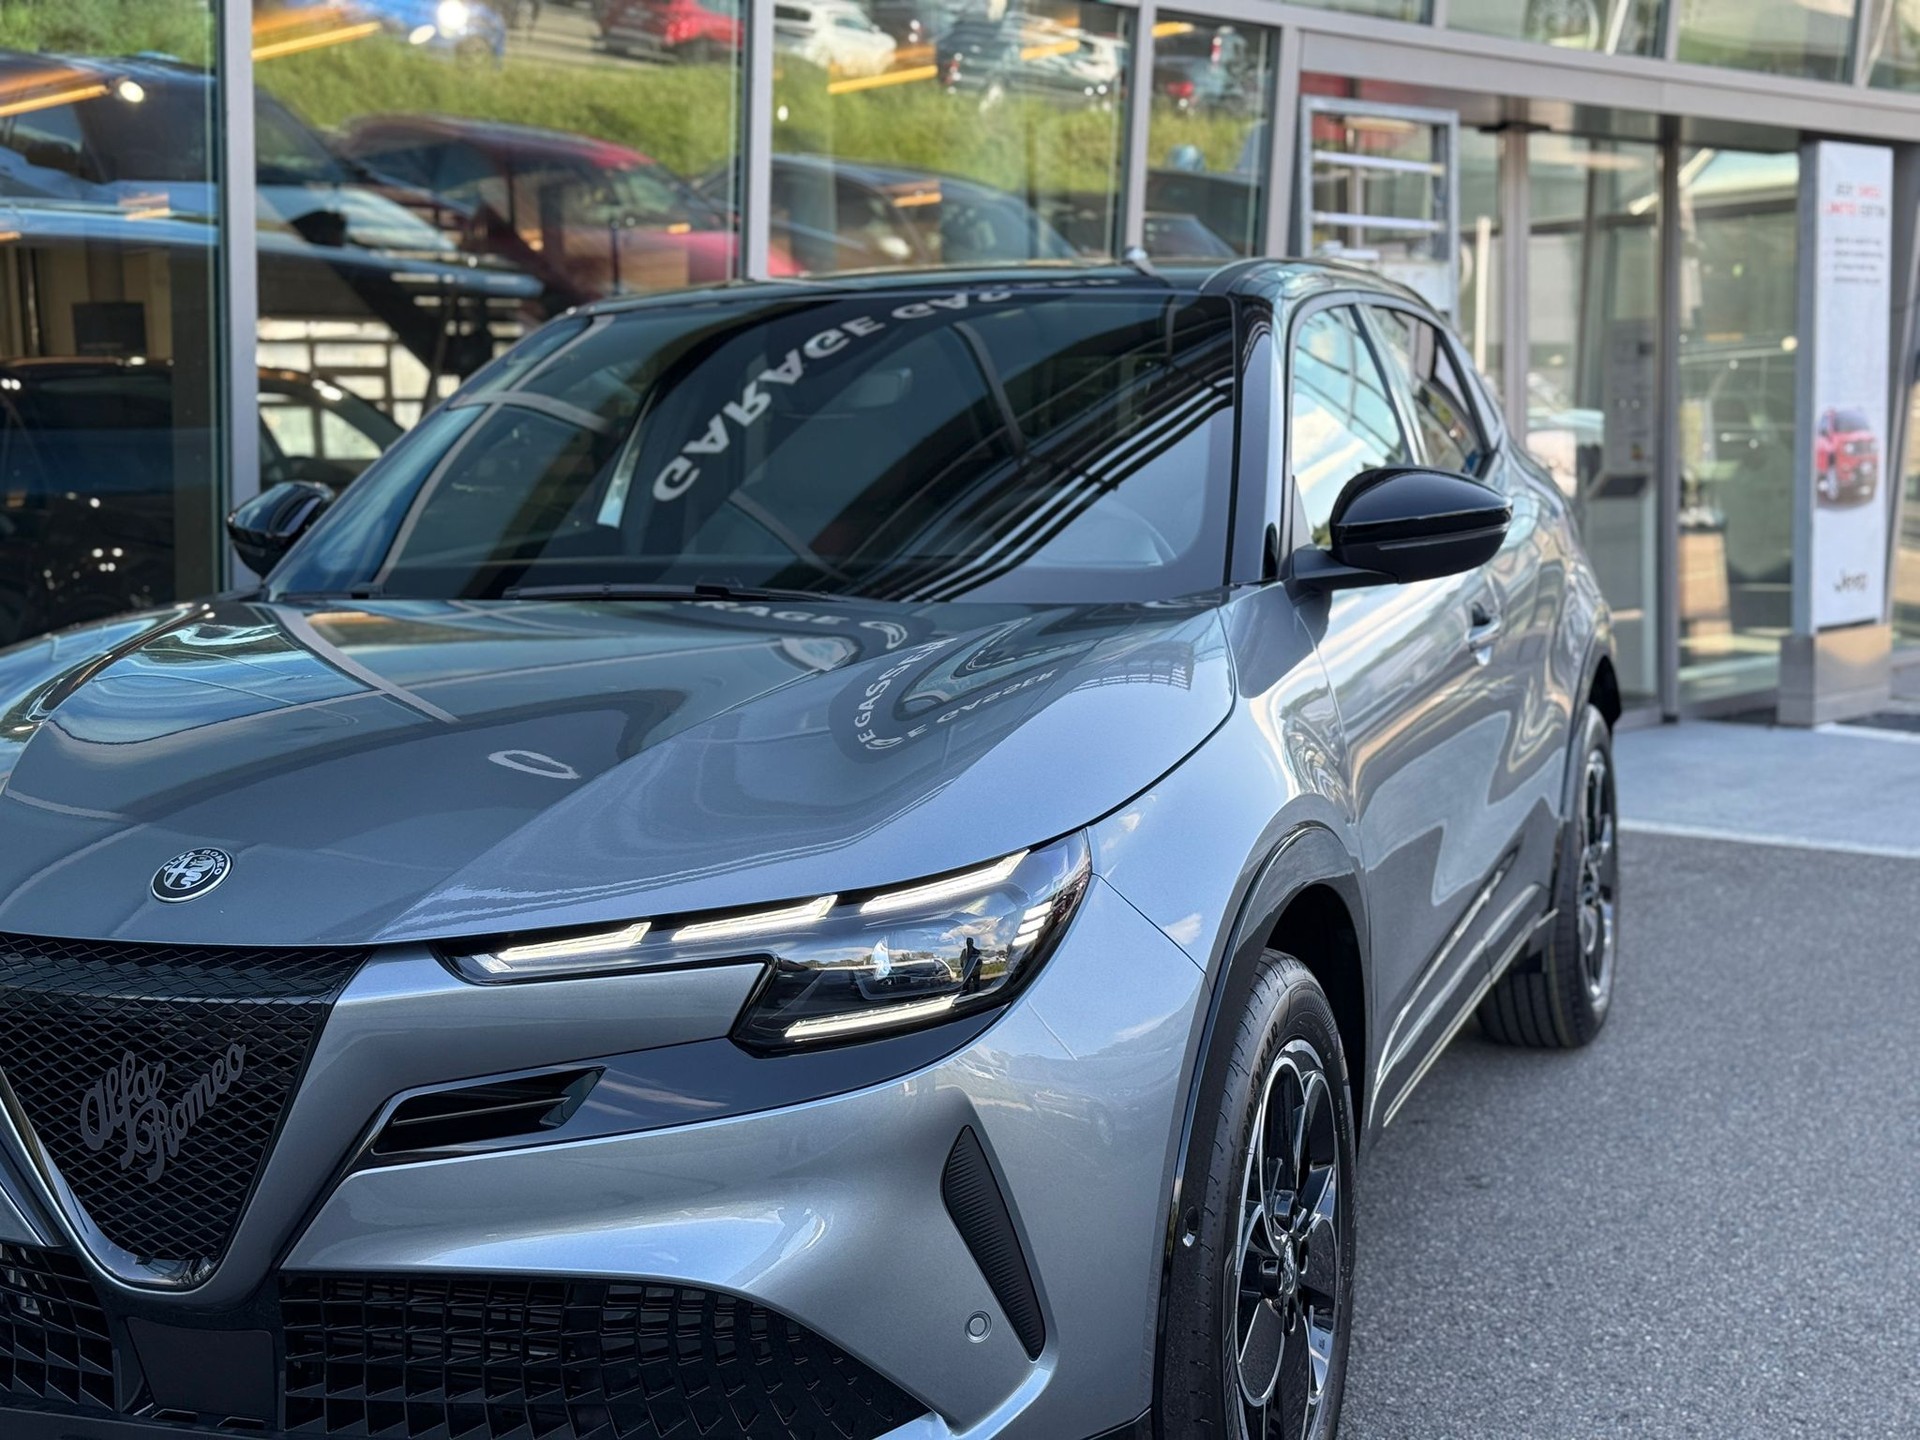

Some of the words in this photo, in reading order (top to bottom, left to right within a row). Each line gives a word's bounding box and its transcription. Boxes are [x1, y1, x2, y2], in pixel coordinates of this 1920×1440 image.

[163, 851, 196, 872] ALFA
[201, 849, 225, 876] ROMEO
[80, 1050, 166, 1170] Alfa
[132, 1043, 246, 1184] Romeo
